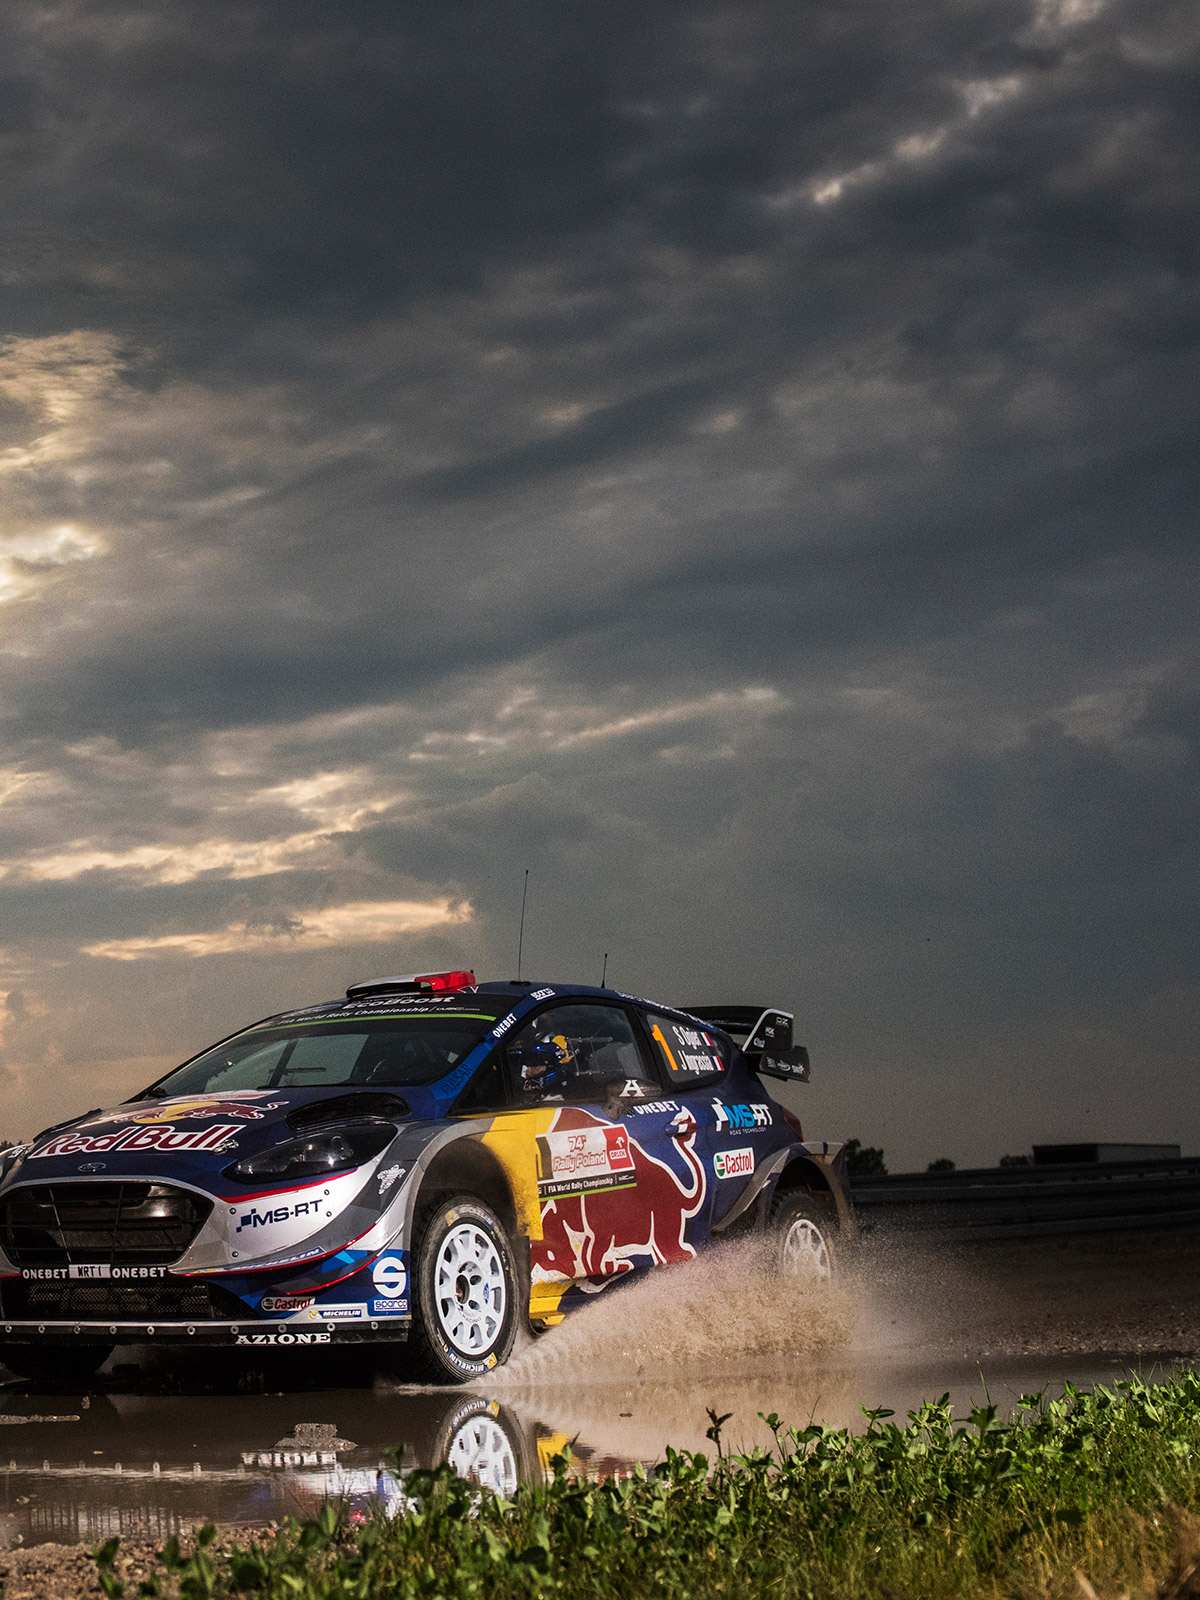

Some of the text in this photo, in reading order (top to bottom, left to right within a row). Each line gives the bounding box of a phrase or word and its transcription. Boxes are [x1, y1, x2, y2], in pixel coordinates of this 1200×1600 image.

[354, 1006, 430, 1017] Championship
[492, 1013, 518, 1039] ONEBET
[652, 1024, 678, 1071] 1
[440, 1064, 473, 1097] PULSAR
[619, 1079, 645, 1097] A
[28, 1125, 246, 1159] Red Bull
[553, 1150, 606, 1173] Rally Poland
[725, 1152, 753, 1174] Castrol
[583, 1177, 614, 1188] Championship
[253, 1199, 323, 1228] MS-RT
[22, 1268, 68, 1279] ONEBET
[112, 1267, 167, 1279] ONEBET
[274, 1298, 312, 1310] Castrol
[375, 1300, 407, 1309] sparco
[235, 1332, 331, 1345] AZIONE
[449, 1352, 485, 1372] MICHELIN
